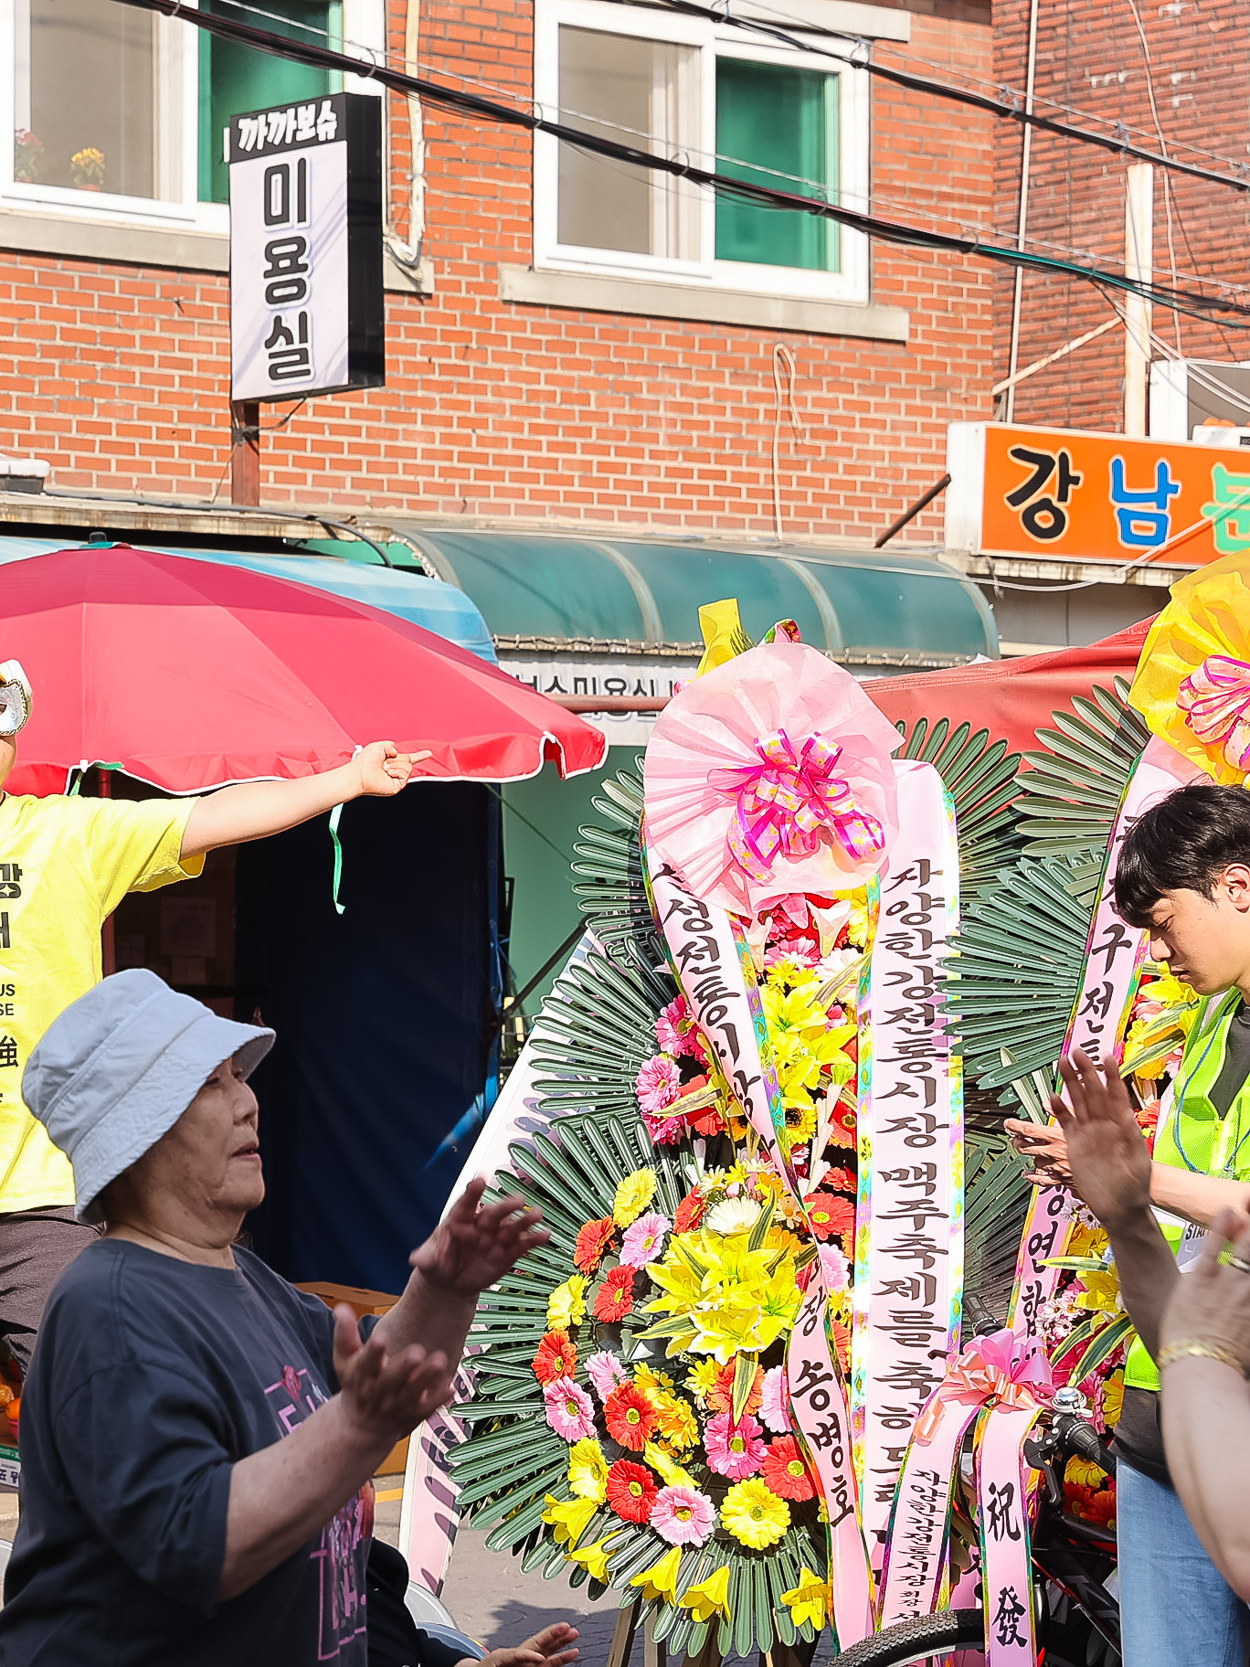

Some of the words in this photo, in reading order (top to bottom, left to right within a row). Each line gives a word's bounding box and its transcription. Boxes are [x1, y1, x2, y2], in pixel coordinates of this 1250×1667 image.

[238, 100, 338, 152] 까까보슈
[263, 157, 312, 381] 미용실
[875, 858, 950, 1148] 자양한강전통시장
[871, 1161, 950, 1348] 맥주축제를
[790, 1359, 855, 1527] 송병호
[893, 1469, 949, 1587] 자양한강전통시장
